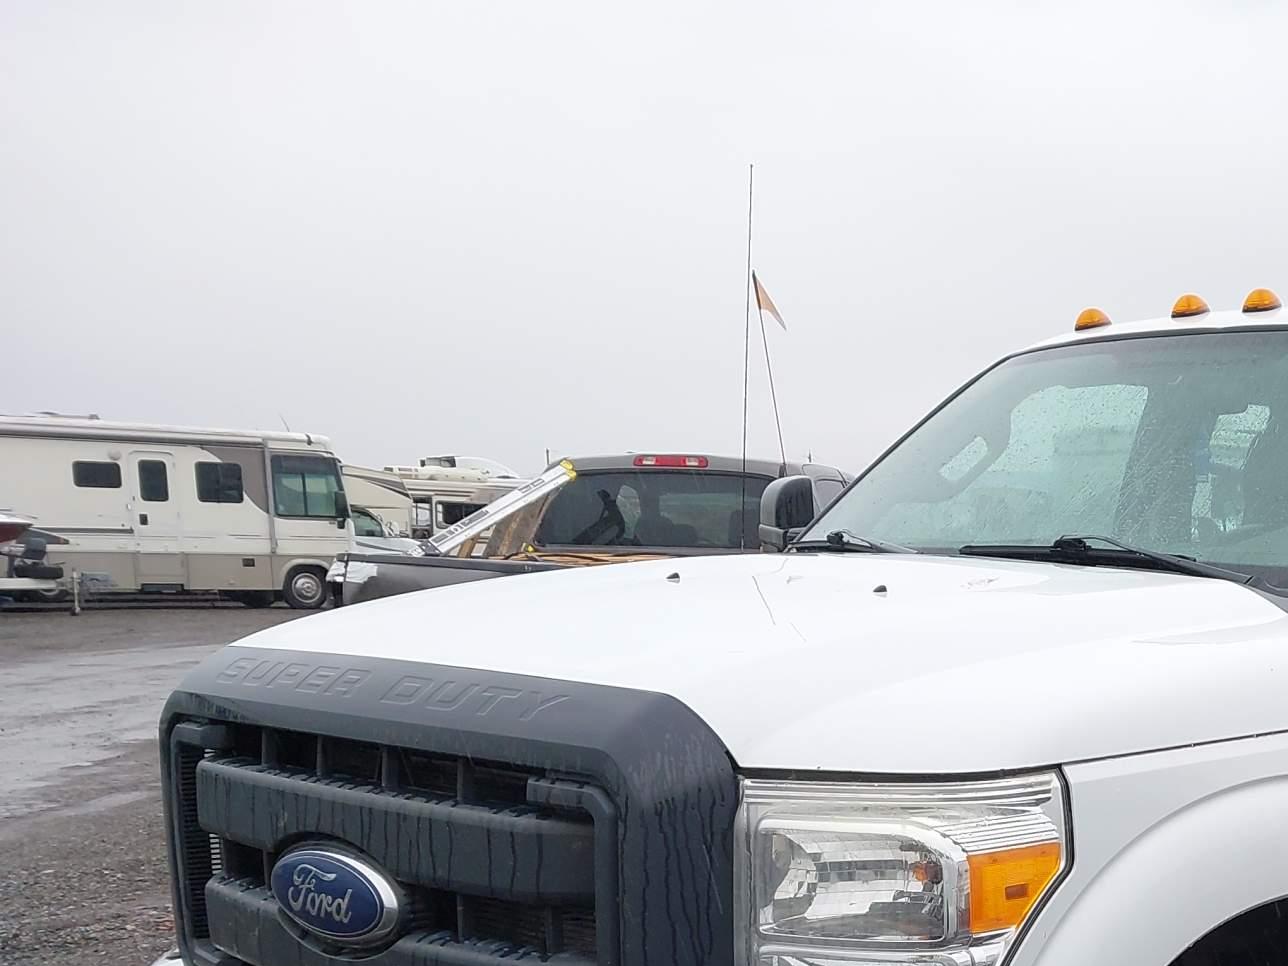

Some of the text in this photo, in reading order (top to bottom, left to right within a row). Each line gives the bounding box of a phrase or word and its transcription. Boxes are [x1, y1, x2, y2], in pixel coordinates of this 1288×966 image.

[216, 656, 569, 721] SUPER DUTY
[287, 862, 353, 924] Ford
